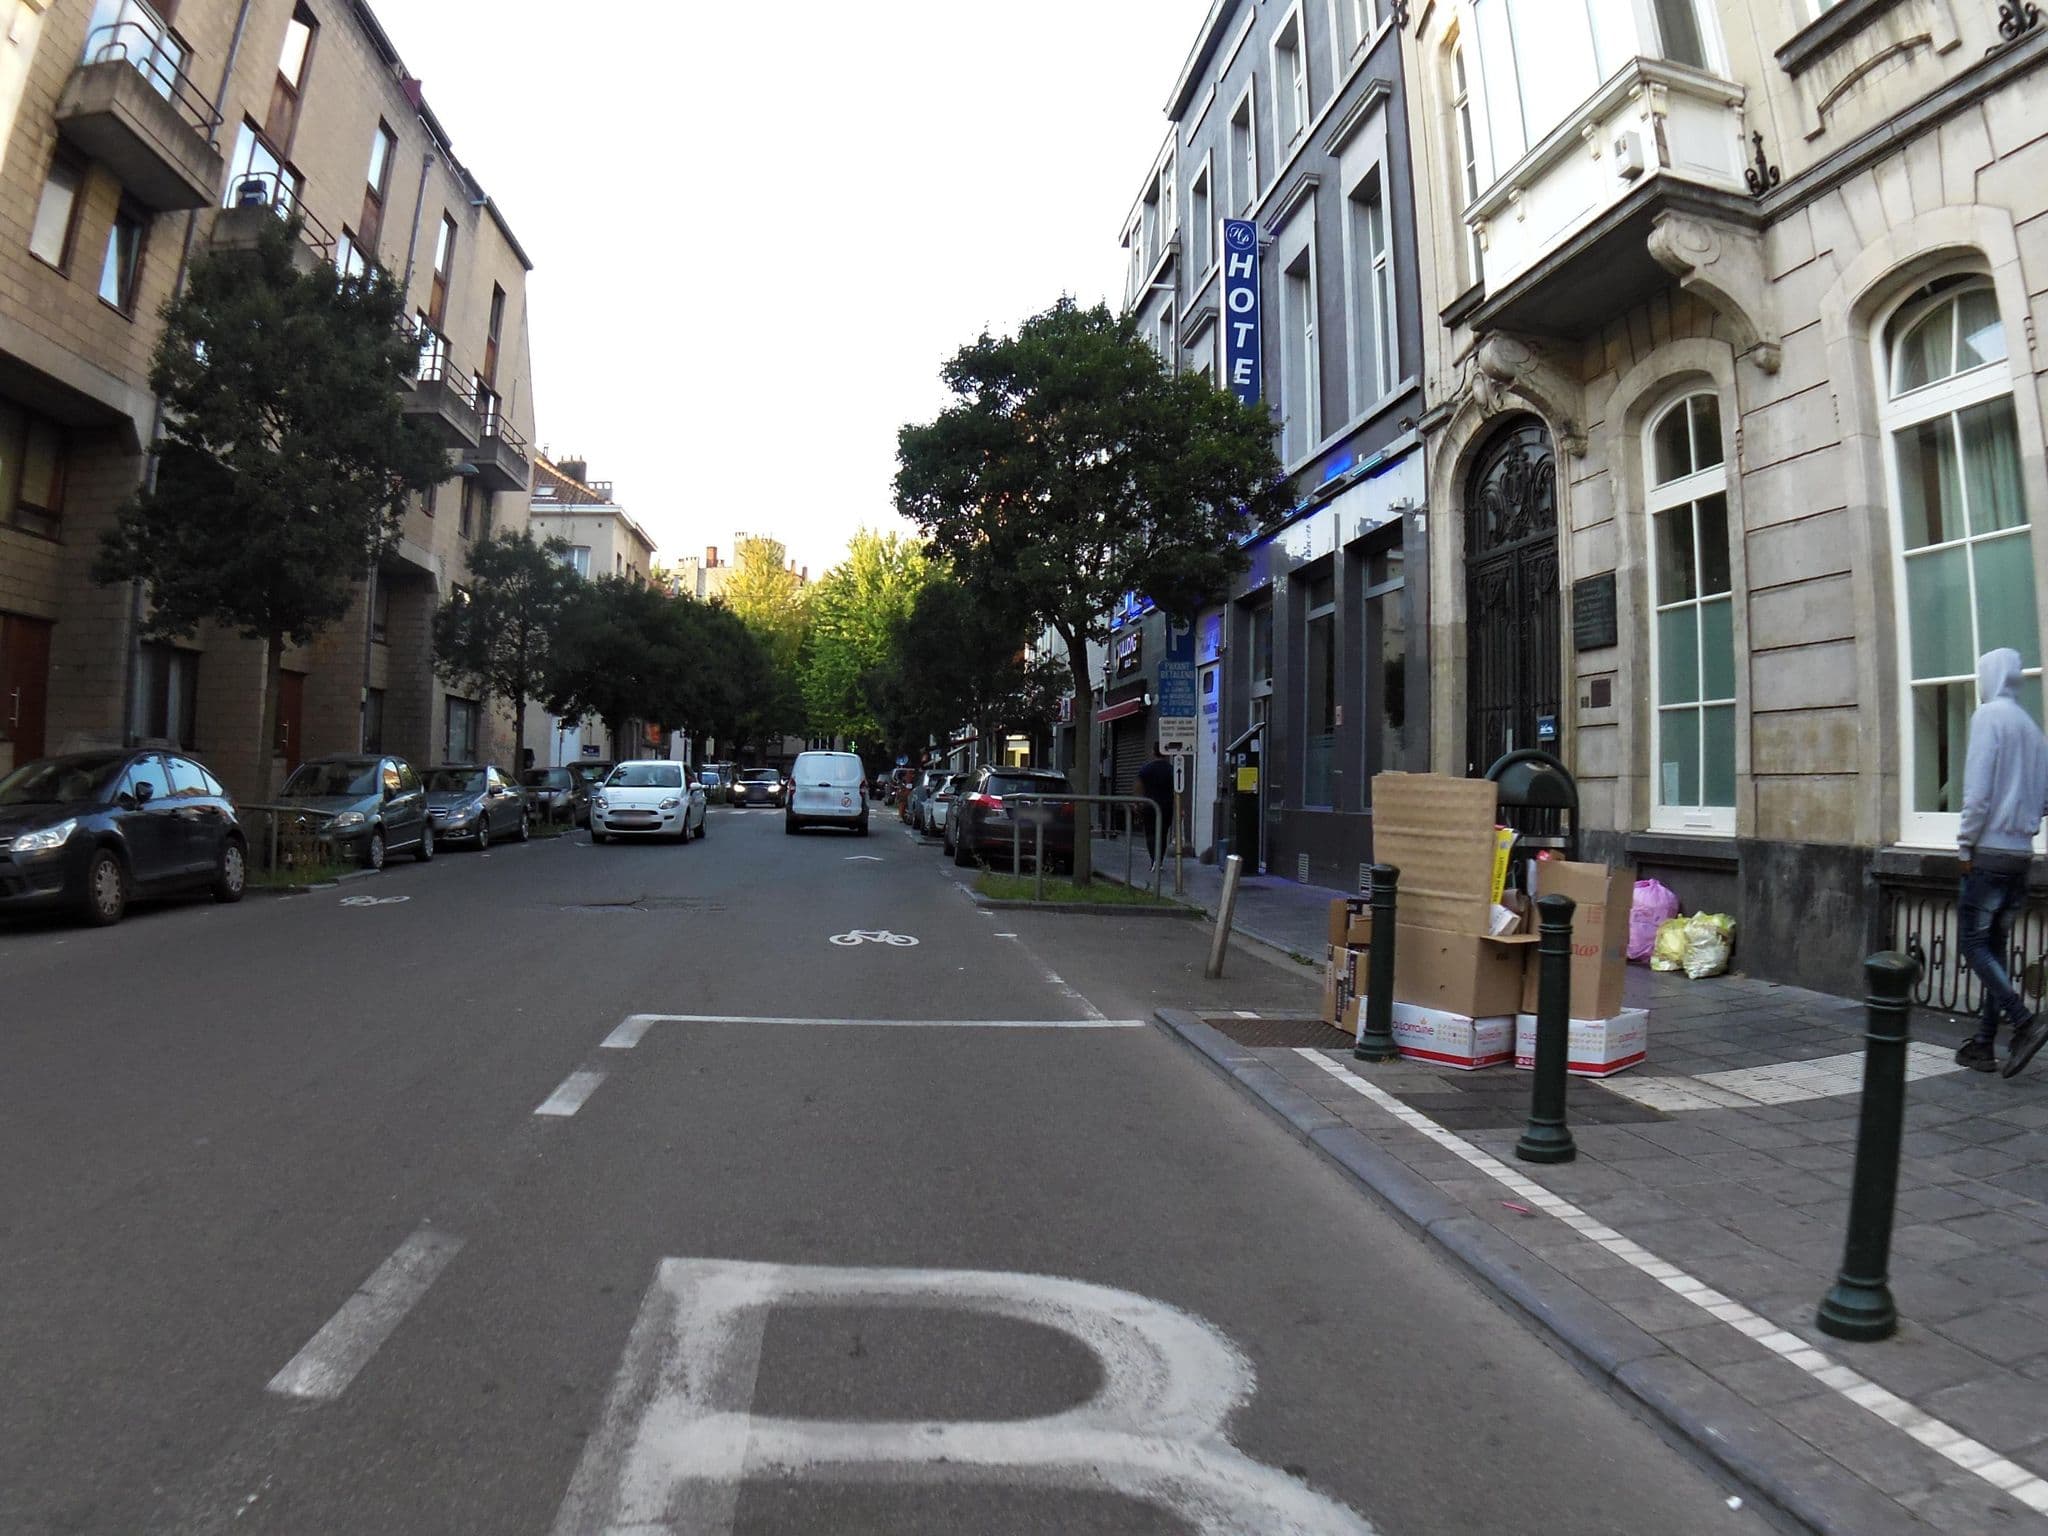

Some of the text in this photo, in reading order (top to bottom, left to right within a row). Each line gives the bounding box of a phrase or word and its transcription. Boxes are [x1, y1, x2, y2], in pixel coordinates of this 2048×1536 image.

[1228, 252, 1255, 403] HOTE
[1171, 618, 1190, 651] P
[1237, 753, 1247, 766] P
